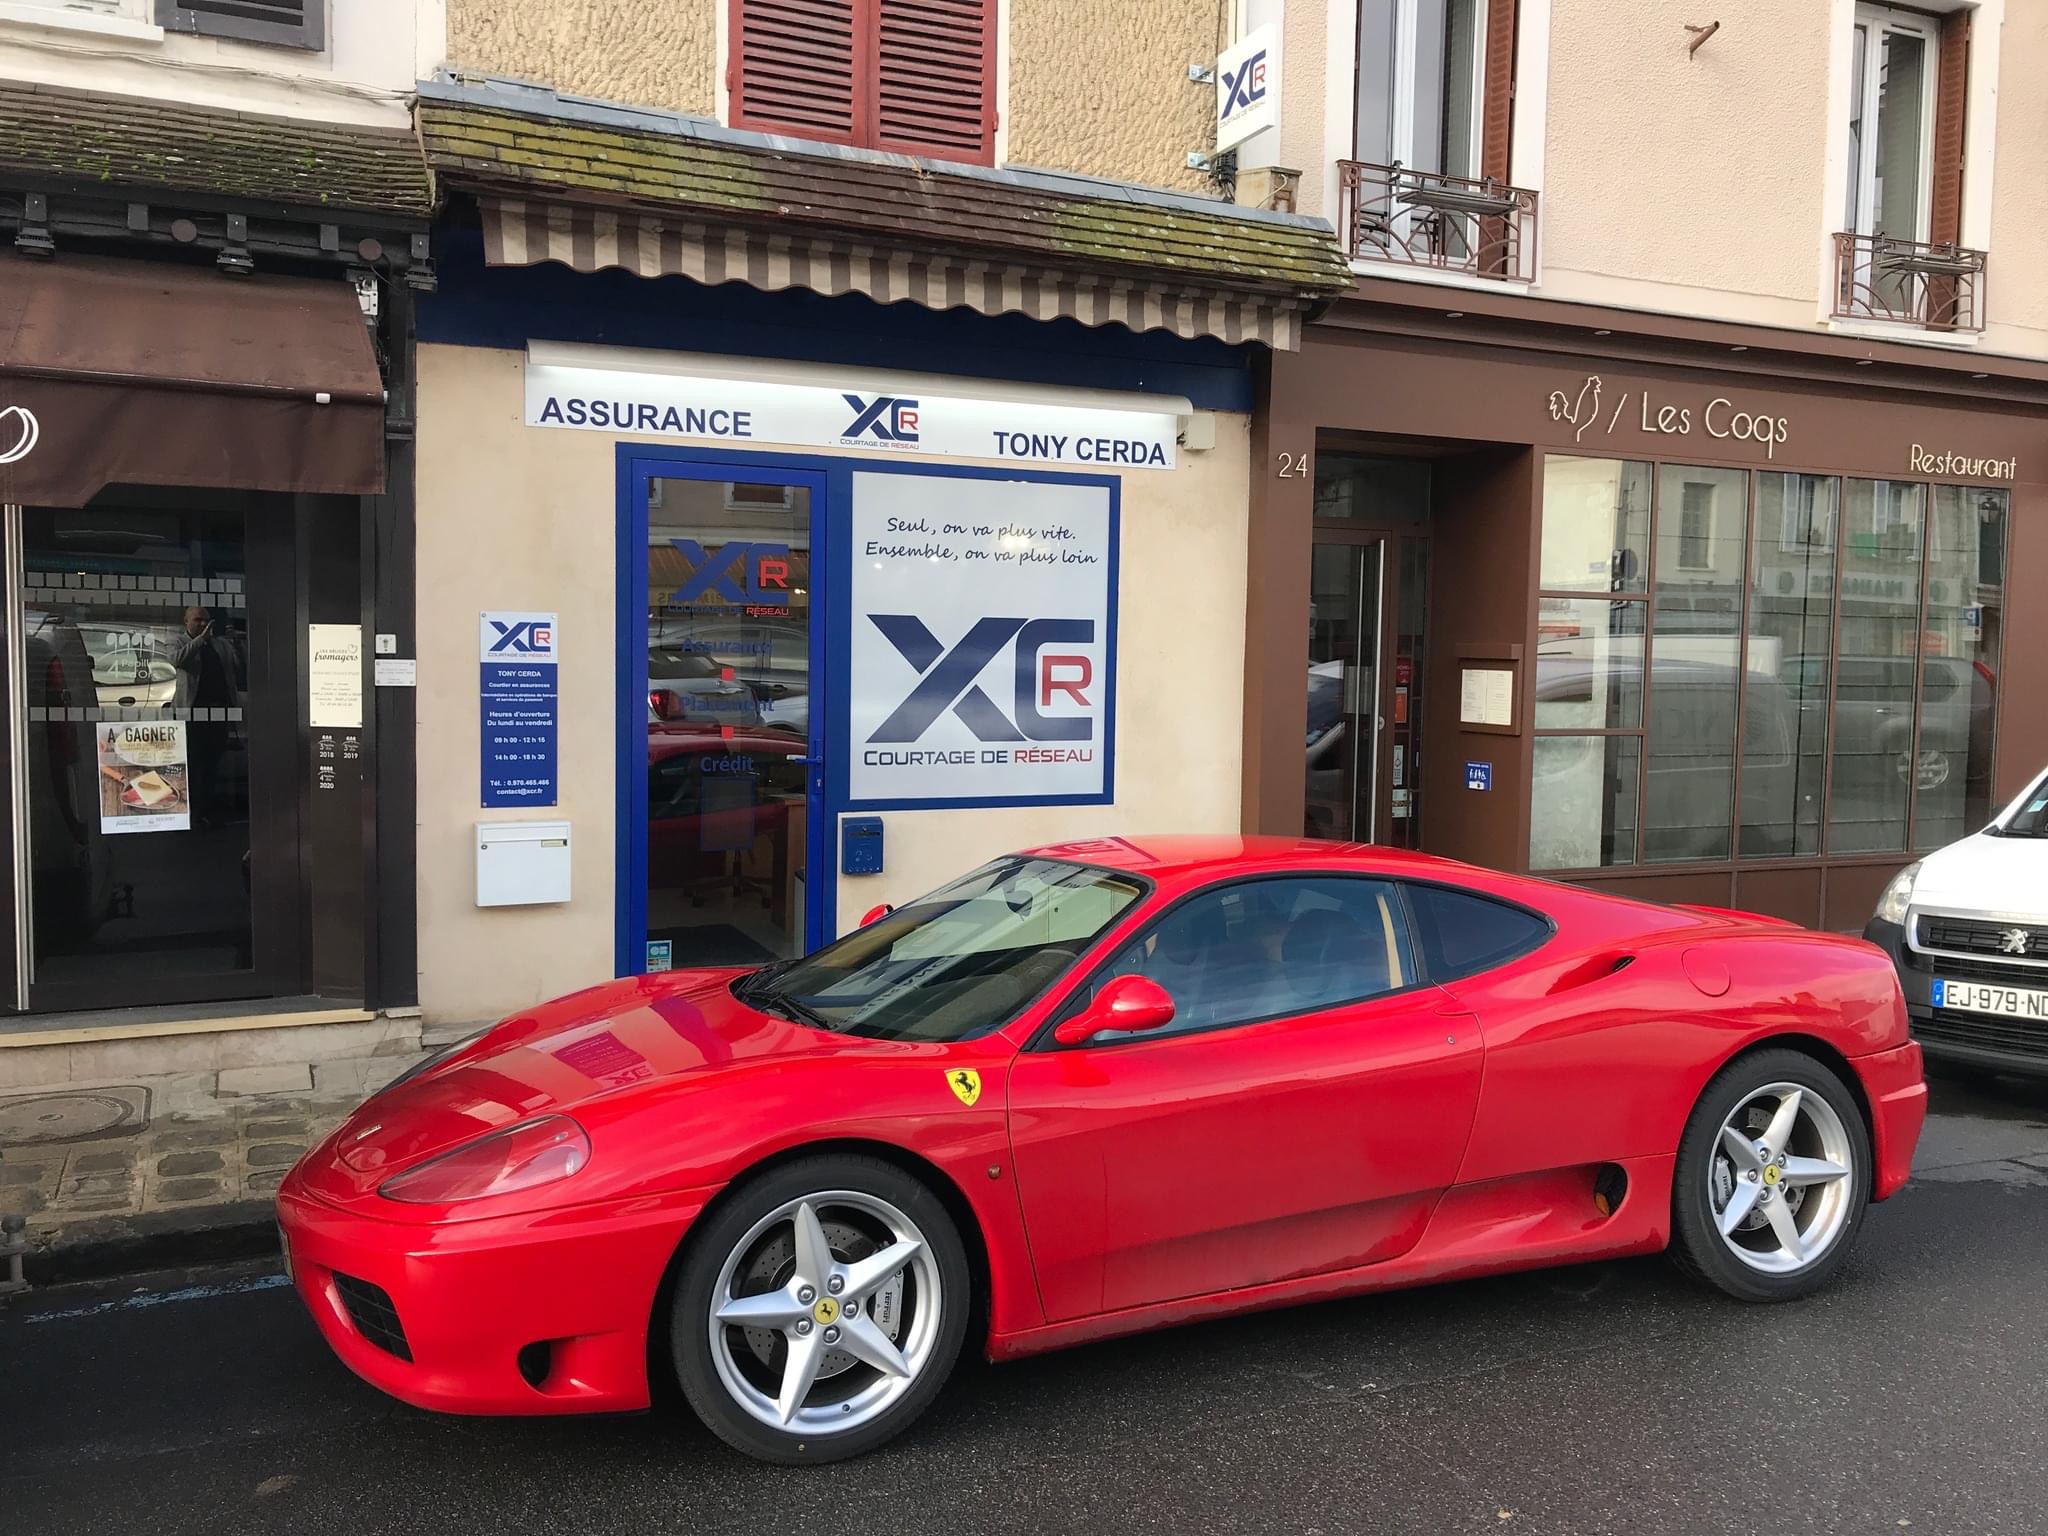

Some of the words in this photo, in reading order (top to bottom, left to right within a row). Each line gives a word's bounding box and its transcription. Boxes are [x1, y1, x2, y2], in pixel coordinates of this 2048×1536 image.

[540, 396, 752, 437] ASSURANCE
[840, 393, 919, 442] XCR
[1641, 391, 1691, 434] Les
[1705, 398, 1788, 459] Coqs
[840, 438, 878, 447] COURTAGE
[993, 431, 1068, 459] TONY
[1076, 437, 1167, 466] CERDA
[1278, 452, 1308, 478] 24
[1910, 443, 2017, 480] Restaurant
[887, 517, 936, 535] Seul,
[943, 523, 967, 534] on
[973, 525, 993, 536] va
[998, 523, 1036, 540] plus
[1041, 525, 1076, 540] vite.
[866, 541, 959, 561] Ensemble,
[965, 550, 989, 561] on
[995, 551, 1015, 562] va
[1019, 549, 1057, 566] plus
[1062, 549, 1098, 564] loin
[488, 621, 551, 652] XCR
[314, 652, 358, 663] fromagers
[865, 614, 1095, 744] XCR
[701, 756, 754, 772] Crédit
[864, 750, 975, 766] COURTAGE
[981, 750, 1008, 764] DE
[1014, 746, 1093, 763] RÉSEAU
